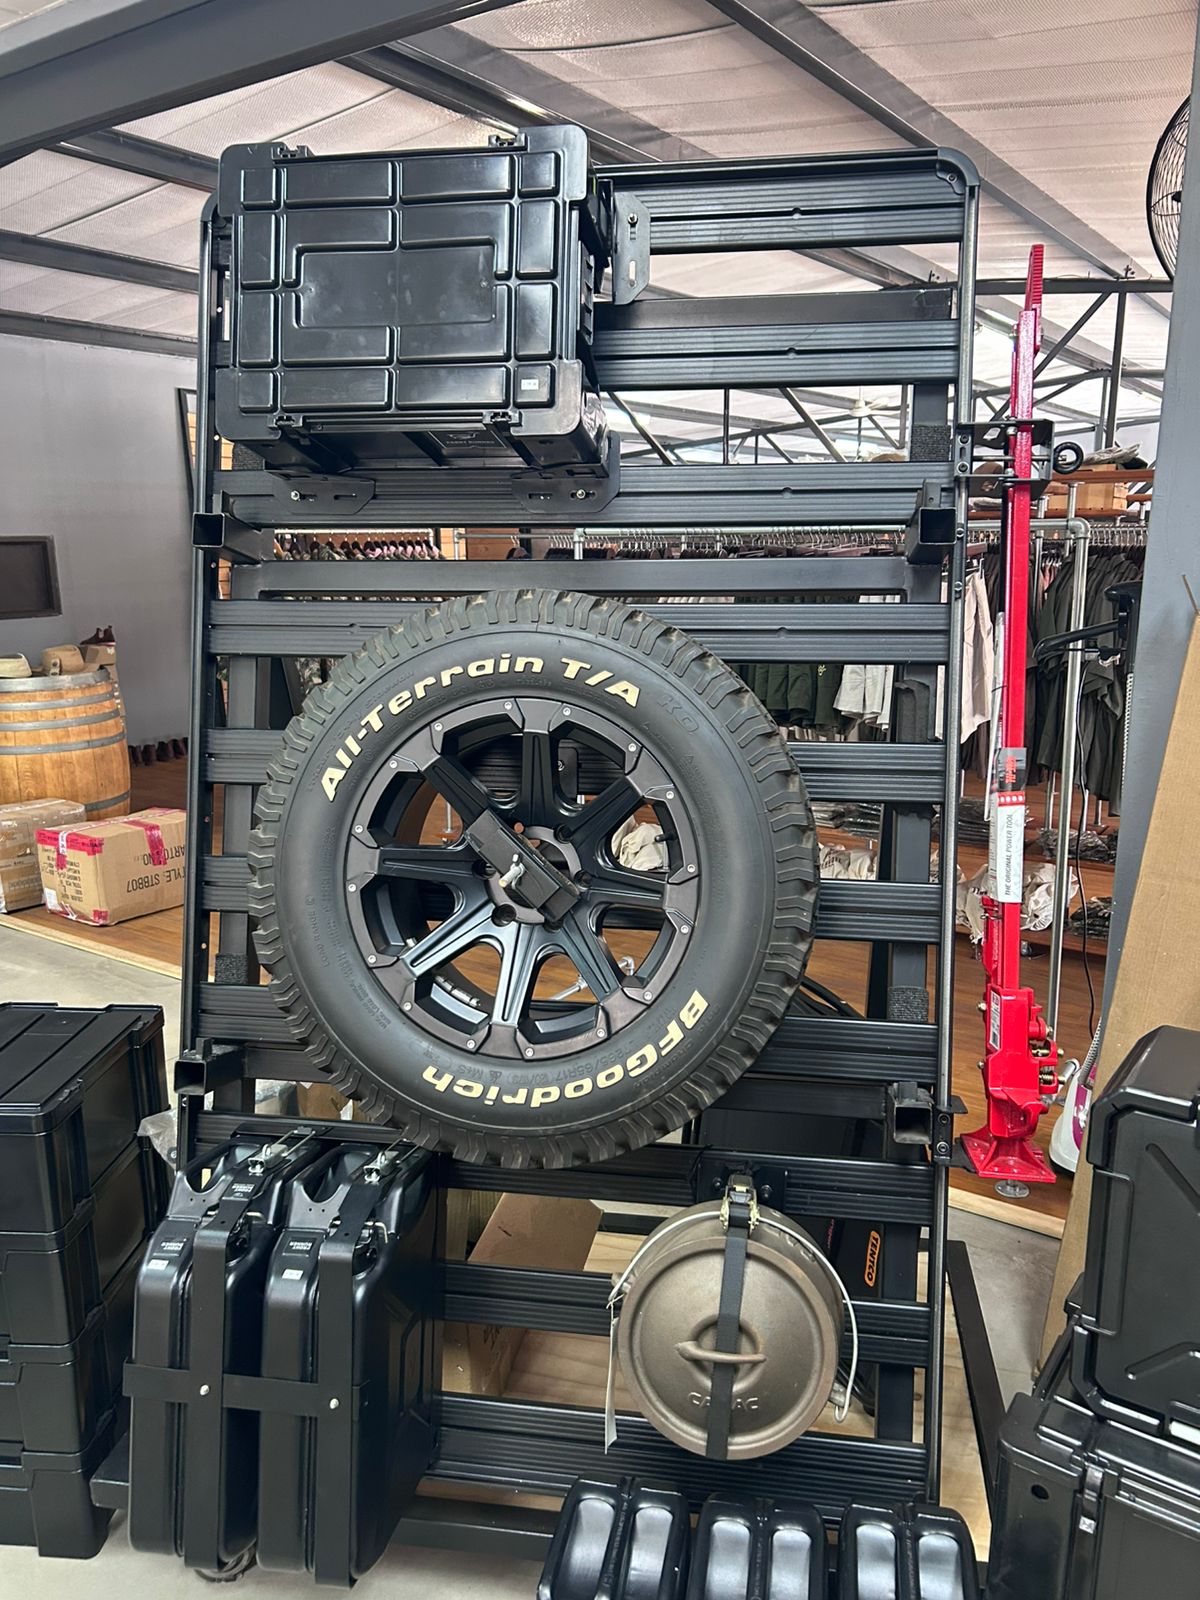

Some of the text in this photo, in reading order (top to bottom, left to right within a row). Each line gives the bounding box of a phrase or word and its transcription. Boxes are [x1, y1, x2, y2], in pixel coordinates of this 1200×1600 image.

[321, 652, 545, 802] All-Terrain
[561, 657, 641, 709] T/A
[126, 873, 161, 893] STBB07
[1004, 884, 1012, 896] THE
[421, 988, 710, 1109] BFGoodrich
[866, 1236, 879, 1281] TENTCO
[687, 1391, 759, 1412] CAAC
